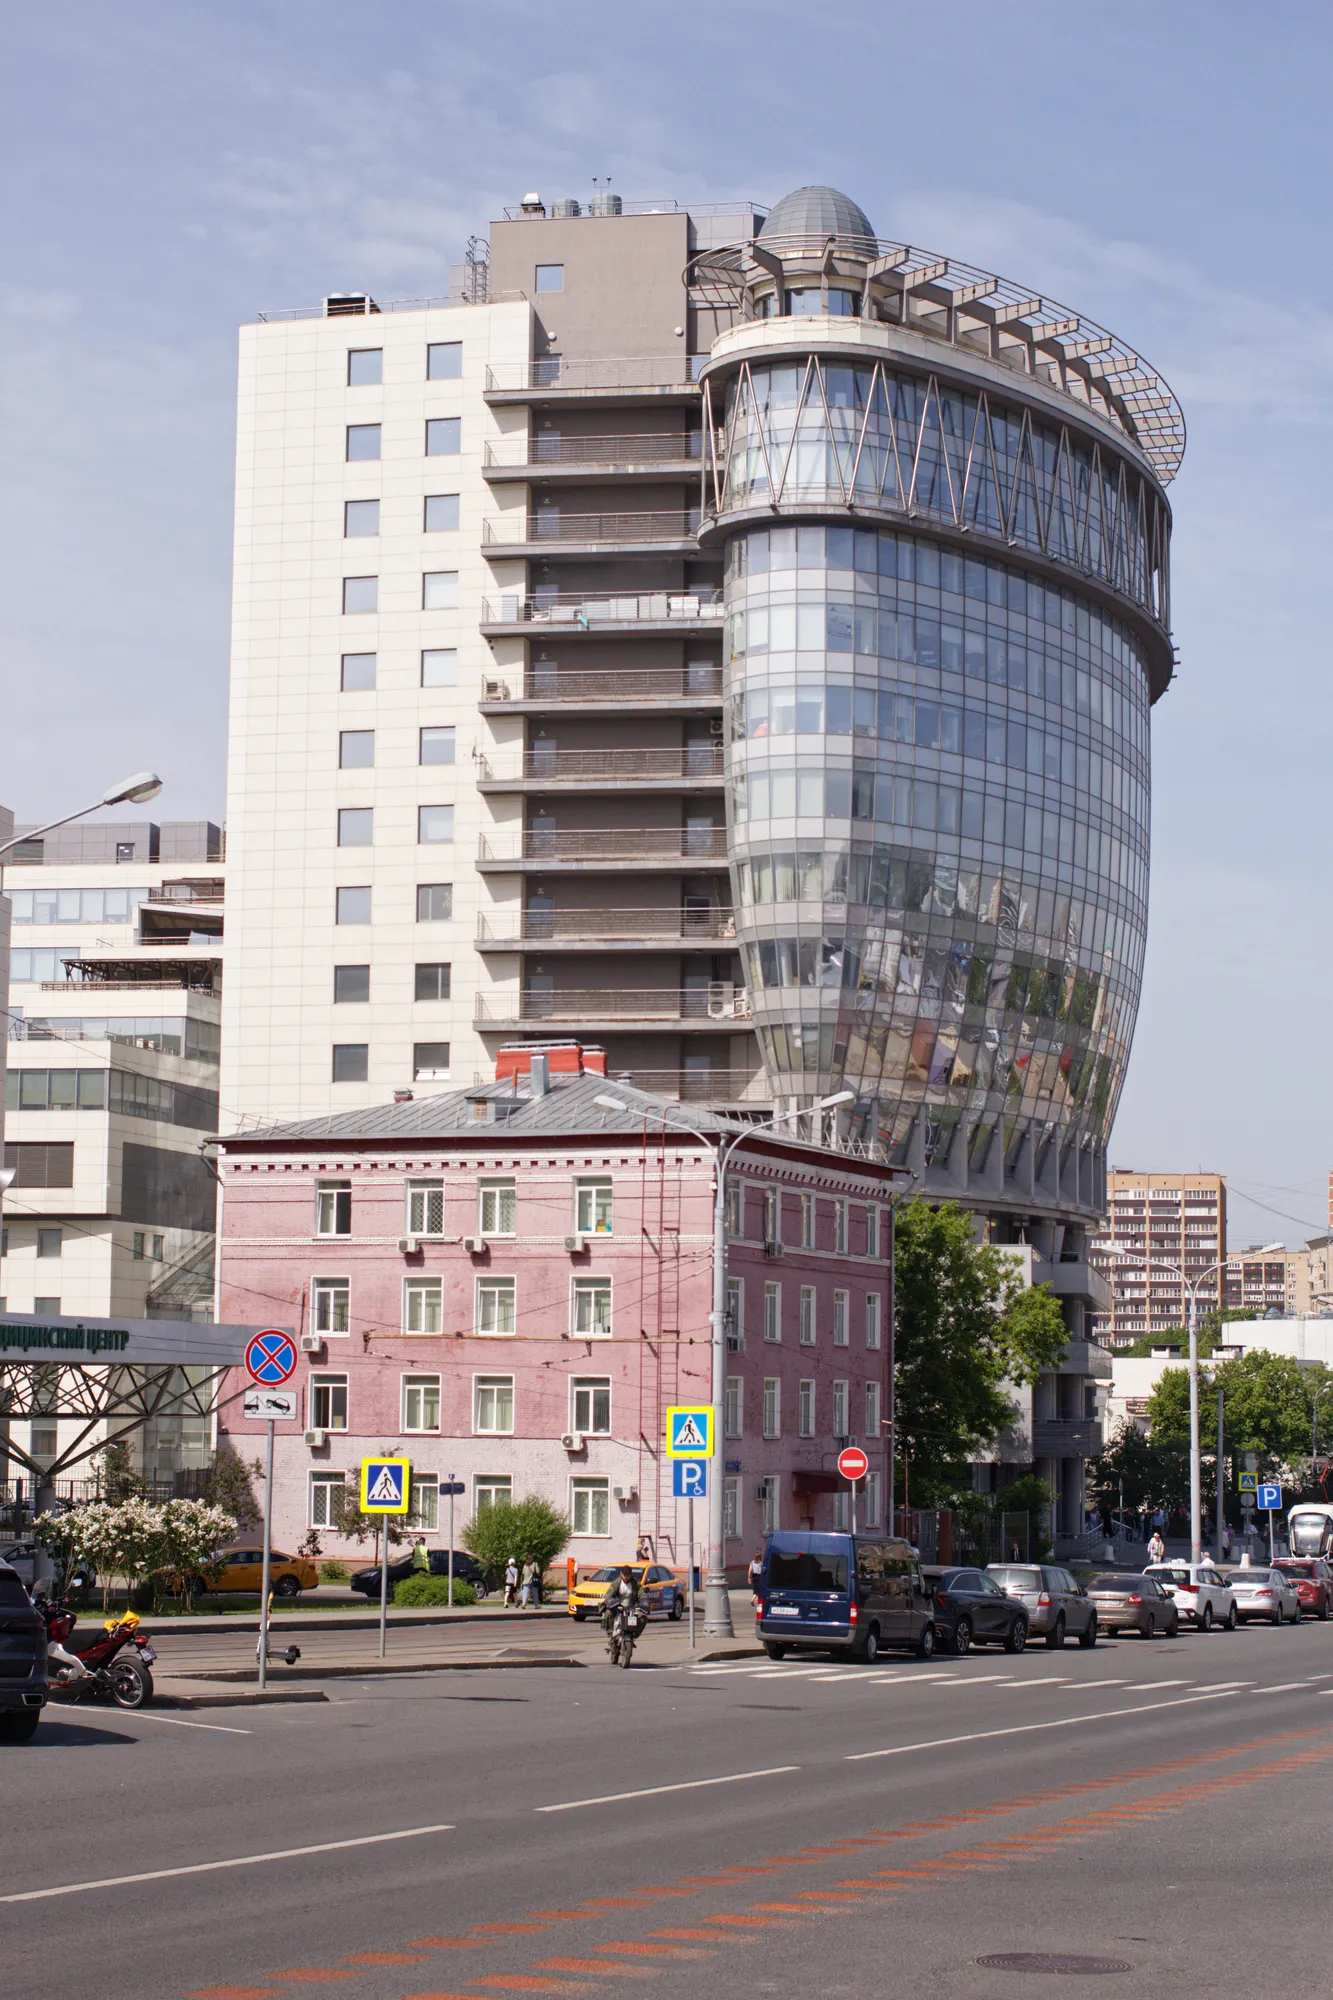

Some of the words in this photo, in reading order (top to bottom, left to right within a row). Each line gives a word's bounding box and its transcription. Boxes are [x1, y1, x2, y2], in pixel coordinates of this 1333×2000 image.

[87, 1329, 130, 1354] ЦЕНТР
[682, 1463, 701, 1493] P
[1264, 1488, 1277, 1506] P
